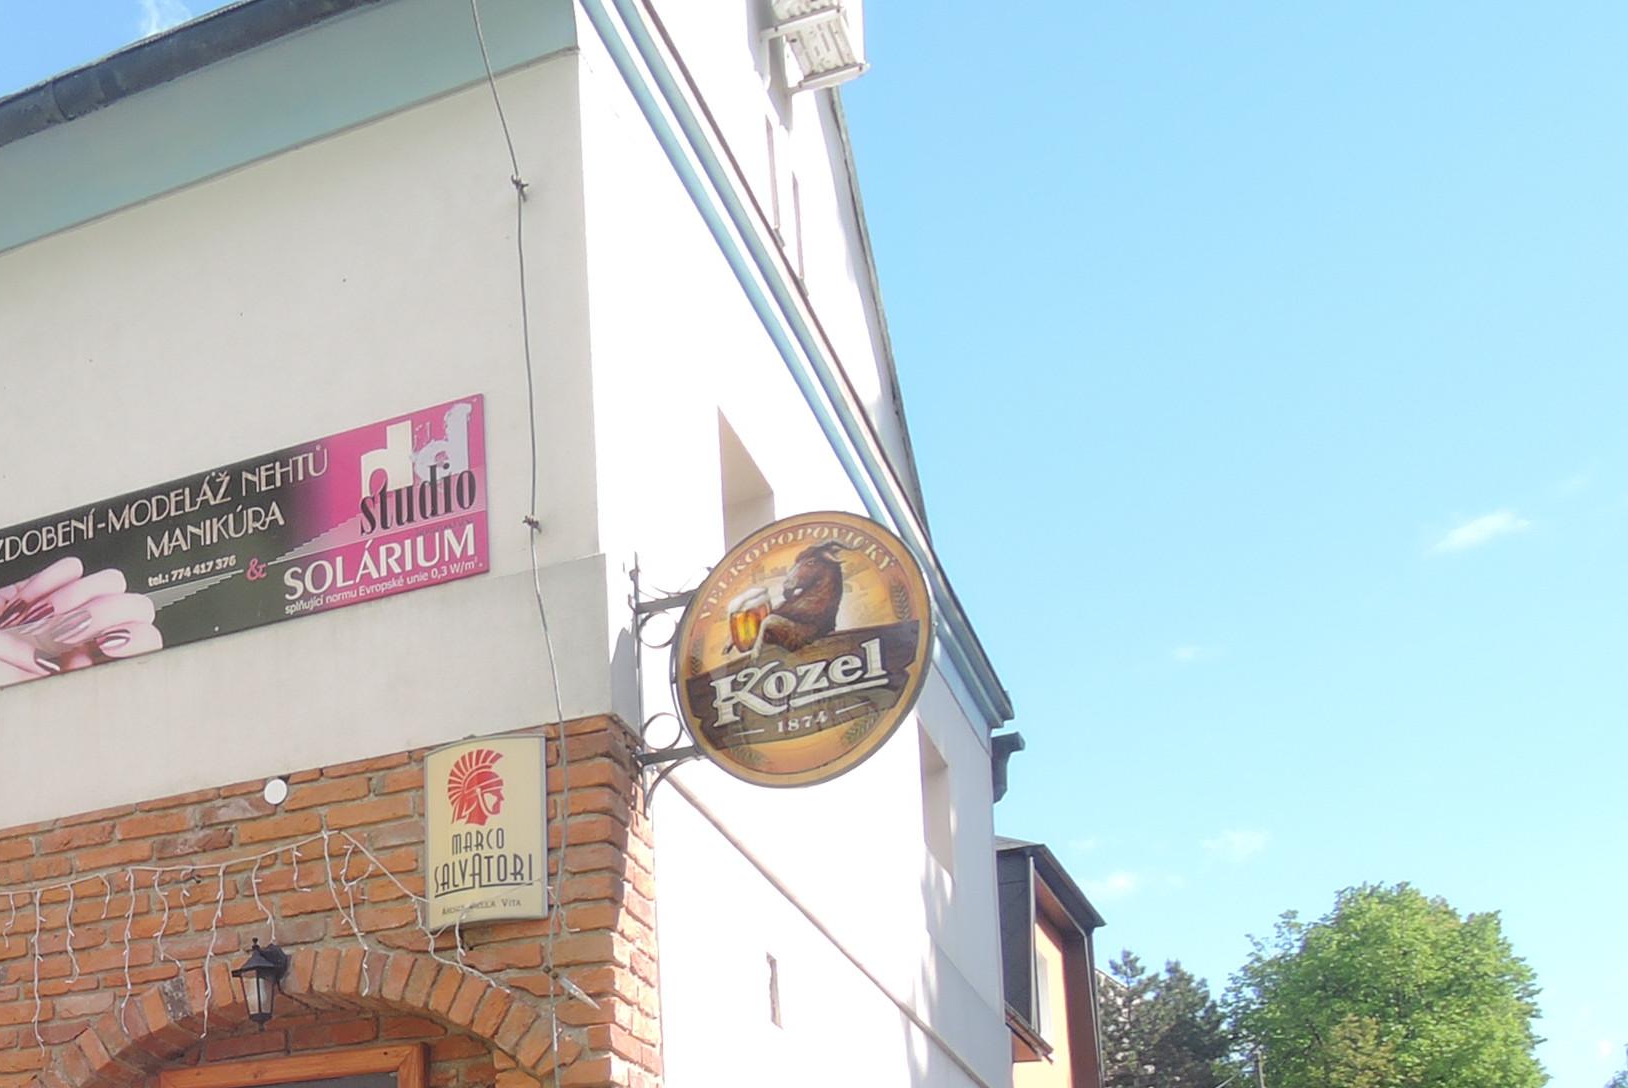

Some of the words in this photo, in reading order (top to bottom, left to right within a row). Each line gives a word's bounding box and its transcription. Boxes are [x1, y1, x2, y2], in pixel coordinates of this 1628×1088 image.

[241, 444, 329, 497] NEHTŮ
[359, 463, 477, 537] studio
[146, 501, 285, 561] MANIKÚRA
[171, 566, 192, 582] 774
[192, 559, 215, 575] 417
[245, 557, 268, 581] &
[283, 522, 476, 601] SOLÁRIUM
[325, 588, 358, 604] normu
[406, 570, 430, 585] unie
[709, 637, 888, 728] Kozel
[776, 710, 829, 733] 1874
[451, 827, 505, 856] MARCO
[434, 852, 533, 893] SALVATORI
